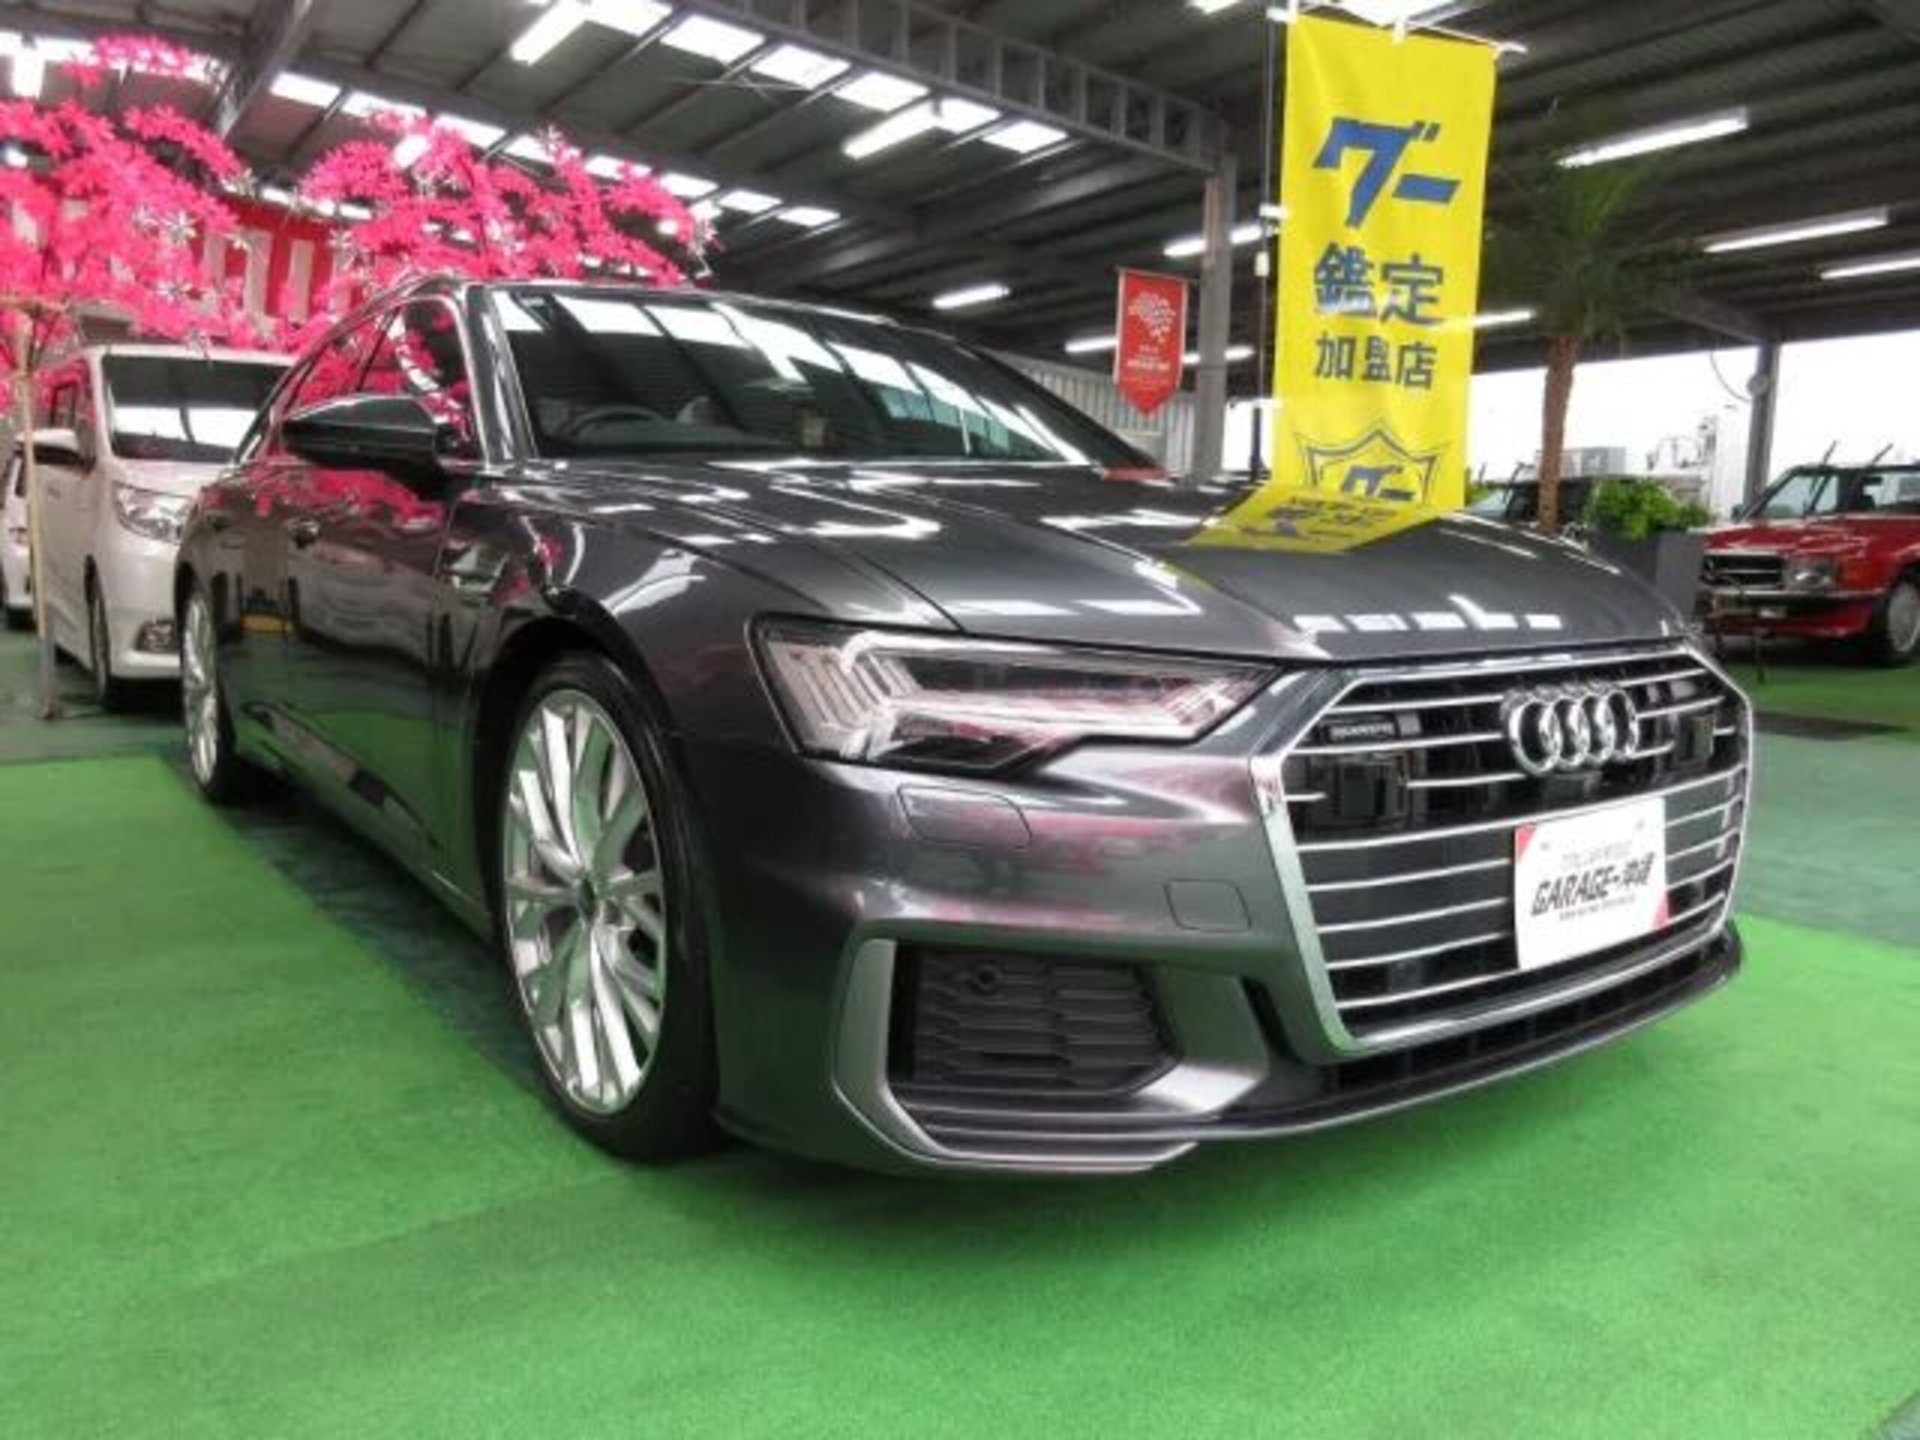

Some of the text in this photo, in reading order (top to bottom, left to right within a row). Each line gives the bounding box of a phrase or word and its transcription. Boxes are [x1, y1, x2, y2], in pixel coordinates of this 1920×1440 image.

[1312, 116, 1461, 230] グー
[1314, 241, 1446, 325] 鑑定
[1314, 331, 1438, 390] 加盟店
